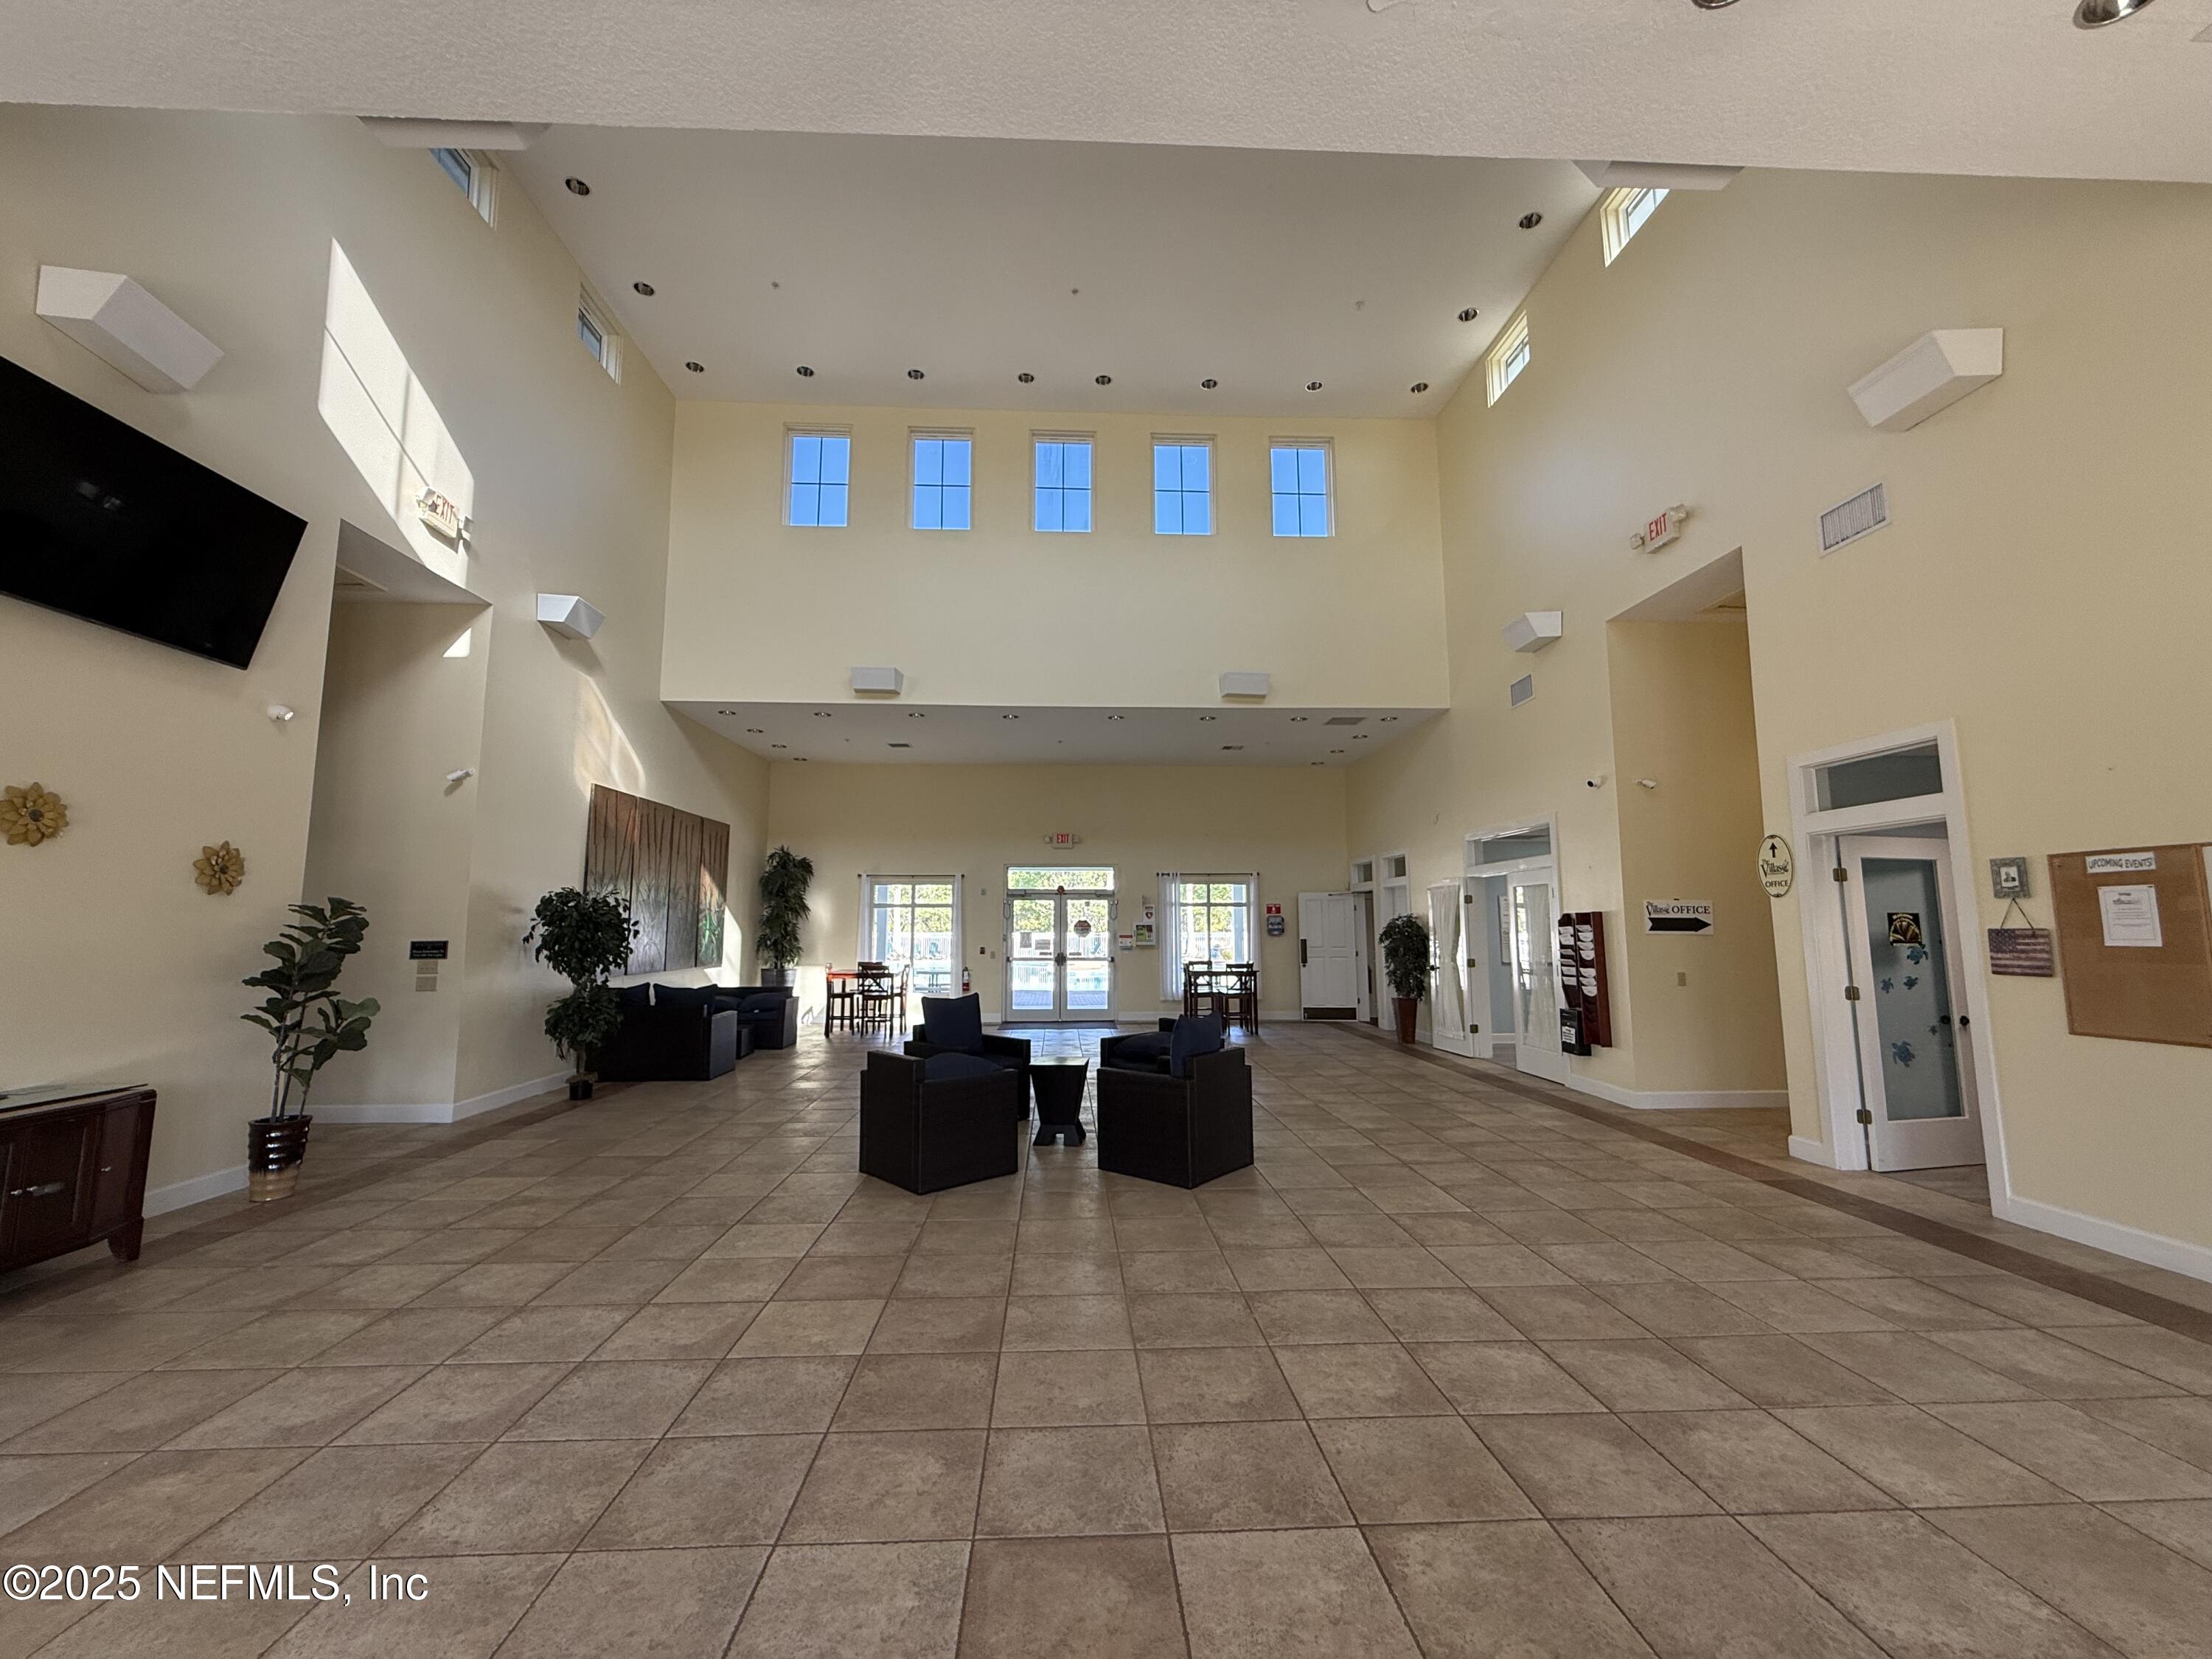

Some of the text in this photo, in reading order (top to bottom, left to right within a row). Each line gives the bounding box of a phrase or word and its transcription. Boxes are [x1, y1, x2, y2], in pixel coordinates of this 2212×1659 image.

[434, 494, 455, 524] EXIT
[1649, 512, 1667, 542] EXIT
[1057, 833, 1069, 844] EXIT
[2088, 858, 2153, 869] UPCOMING EVENTS
[1672, 905, 1711, 914] OFFICE
